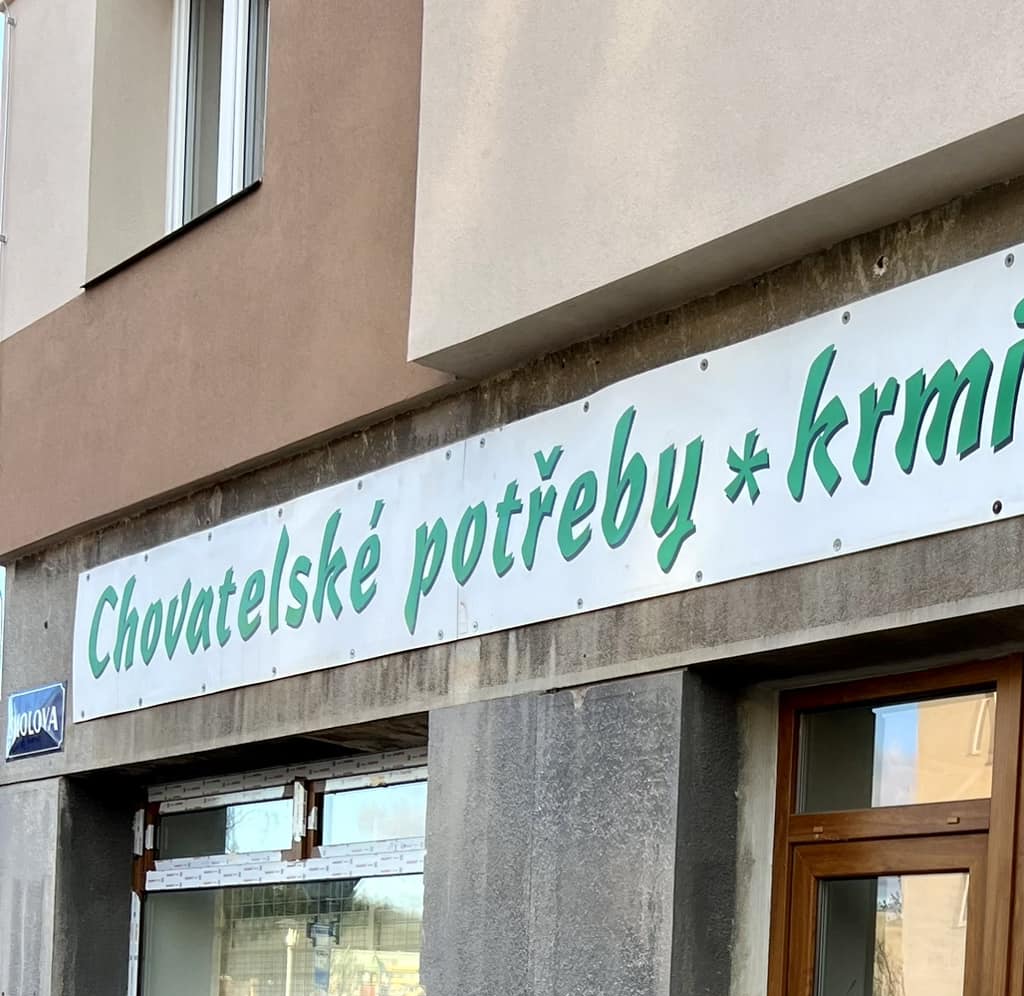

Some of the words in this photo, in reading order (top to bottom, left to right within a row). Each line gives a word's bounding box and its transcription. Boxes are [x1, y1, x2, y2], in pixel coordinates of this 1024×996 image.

[87, 499, 386, 679] Chovatelské
[403, 405, 704, 633] potřeby
[15, 705, 59, 738] OLOVA
